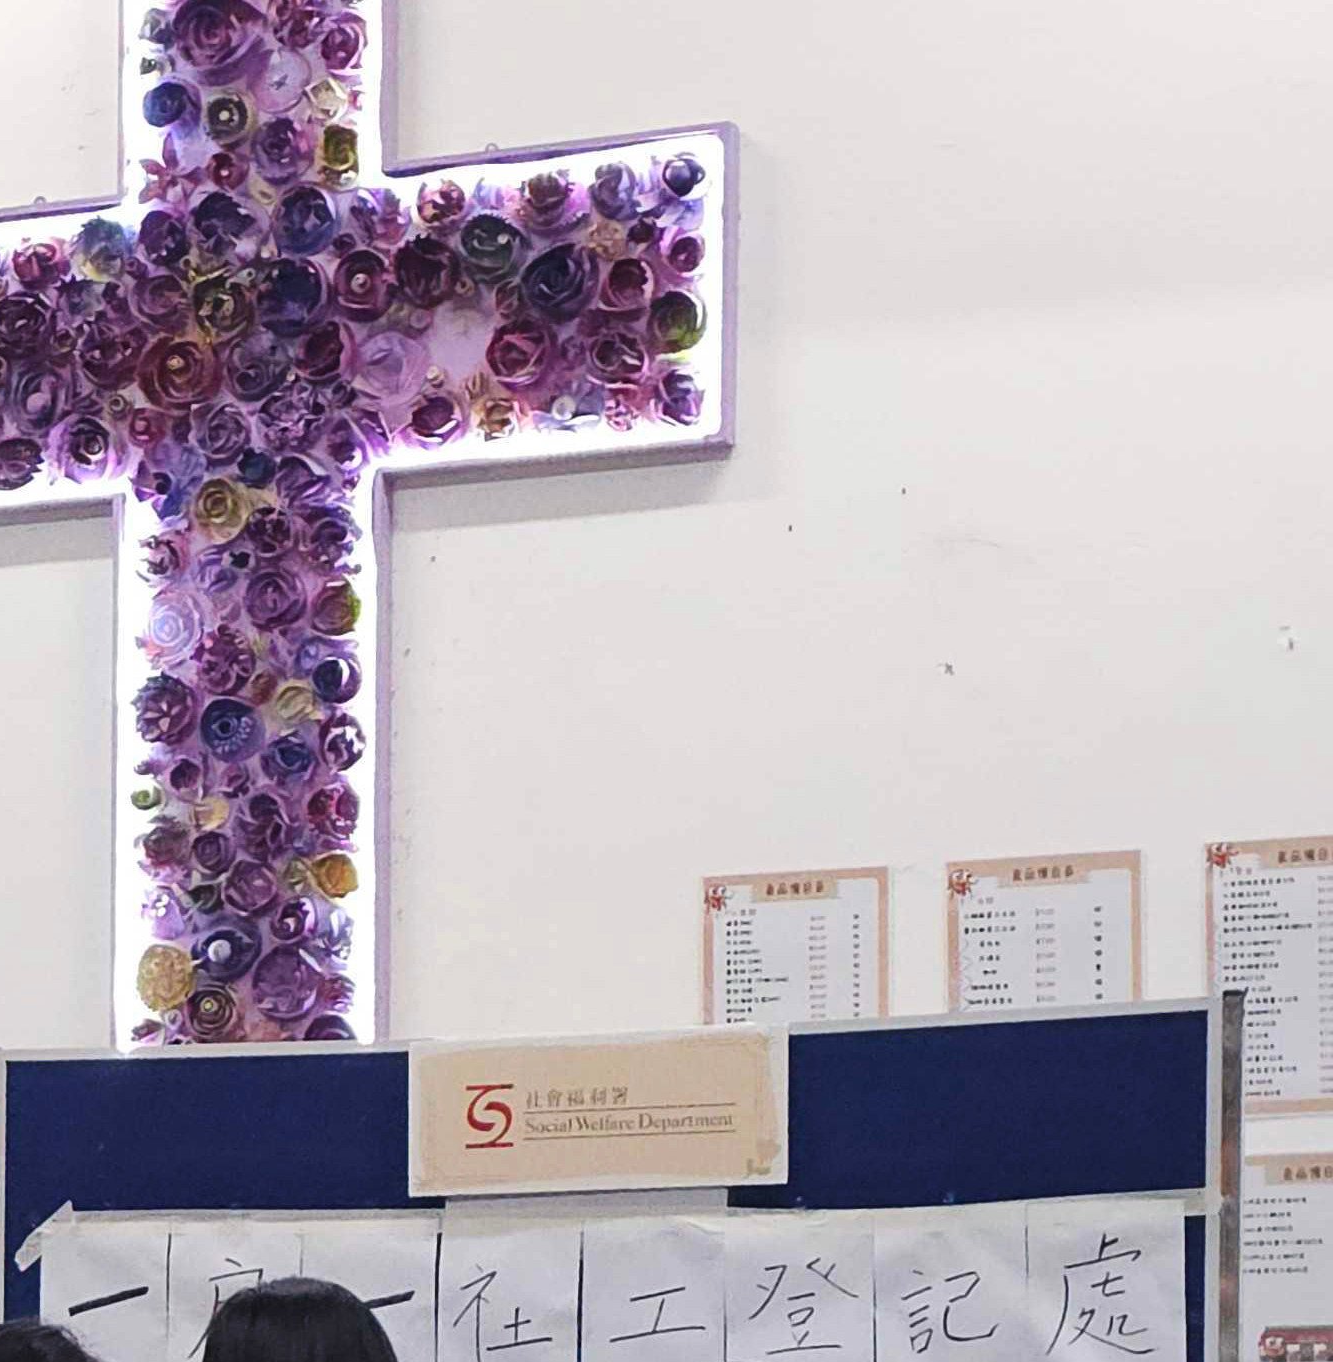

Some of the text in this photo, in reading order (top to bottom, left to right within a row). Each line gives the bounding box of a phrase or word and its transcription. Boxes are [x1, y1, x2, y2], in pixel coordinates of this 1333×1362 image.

[524, 1106, 734, 1134] Social Welfare Department
